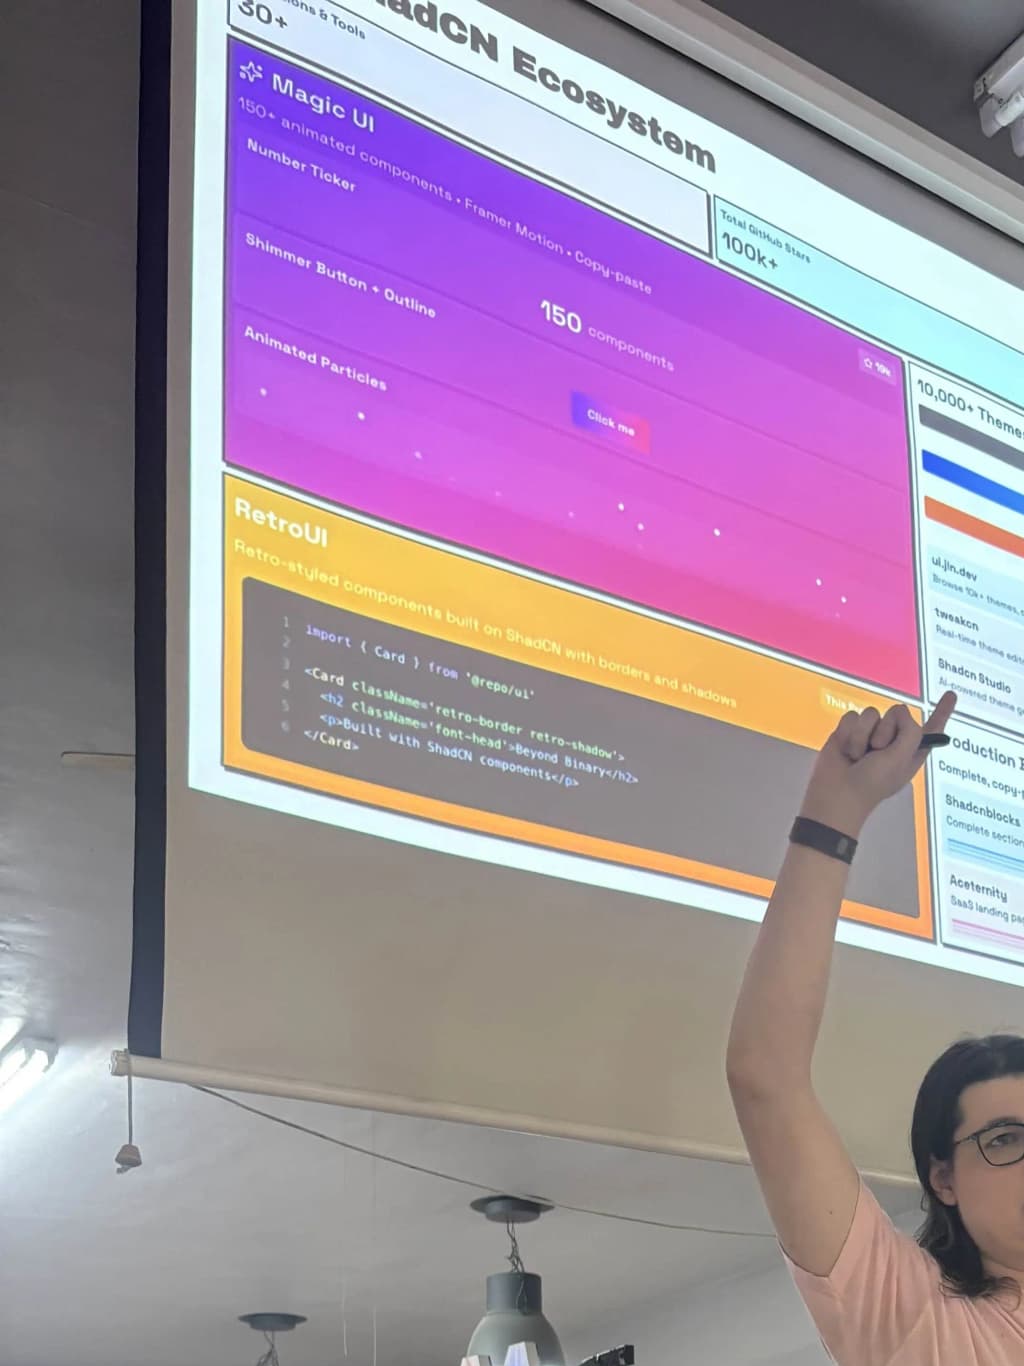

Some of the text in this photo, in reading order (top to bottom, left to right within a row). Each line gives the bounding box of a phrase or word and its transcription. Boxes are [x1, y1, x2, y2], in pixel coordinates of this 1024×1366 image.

[331, 14, 366, 39] Tools
[272, 74, 375, 132] Magic UI
[376, 0, 716, 174] adCN Ecosystem
[247, 138, 356, 192] Number Ticker
[239, 97, 652, 294] 150+ animated components Framer Motion Copy-paste
[720, 209, 811, 263] Total GitHub Stars
[722, 232, 778, 269] 100k+
[246, 232, 436, 318] Shimmer Button + Outline
[541, 300, 675, 371] 150 components
[244, 325, 388, 391] Animated Particles
[917, 378, 974, 412] 10,000+
[587, 409, 635, 436] Click me
[234, 497, 327, 548] RetroUI
[234, 539, 737, 708] Retro-styled components built on ShadCN with borders and shadows
[934, 607, 979, 632] tweakcn
[306, 624, 351, 648] import
[375, 646, 405, 664] Card
[428, 661, 458, 680] from
[304, 667, 345, 687] <Card
[938, 658, 1012, 694] Shadcn Studio
[389, 732, 420, 749] with
[427, 740, 472, 762] ShadCN
[950, 736, 1016, 769] oduction
[938, 760, 991, 788] Complete,
[945, 794, 1022, 827] Shadcnblocks
[946, 815, 990, 837] Complete
[950, 874, 1008, 903] Aceternity
